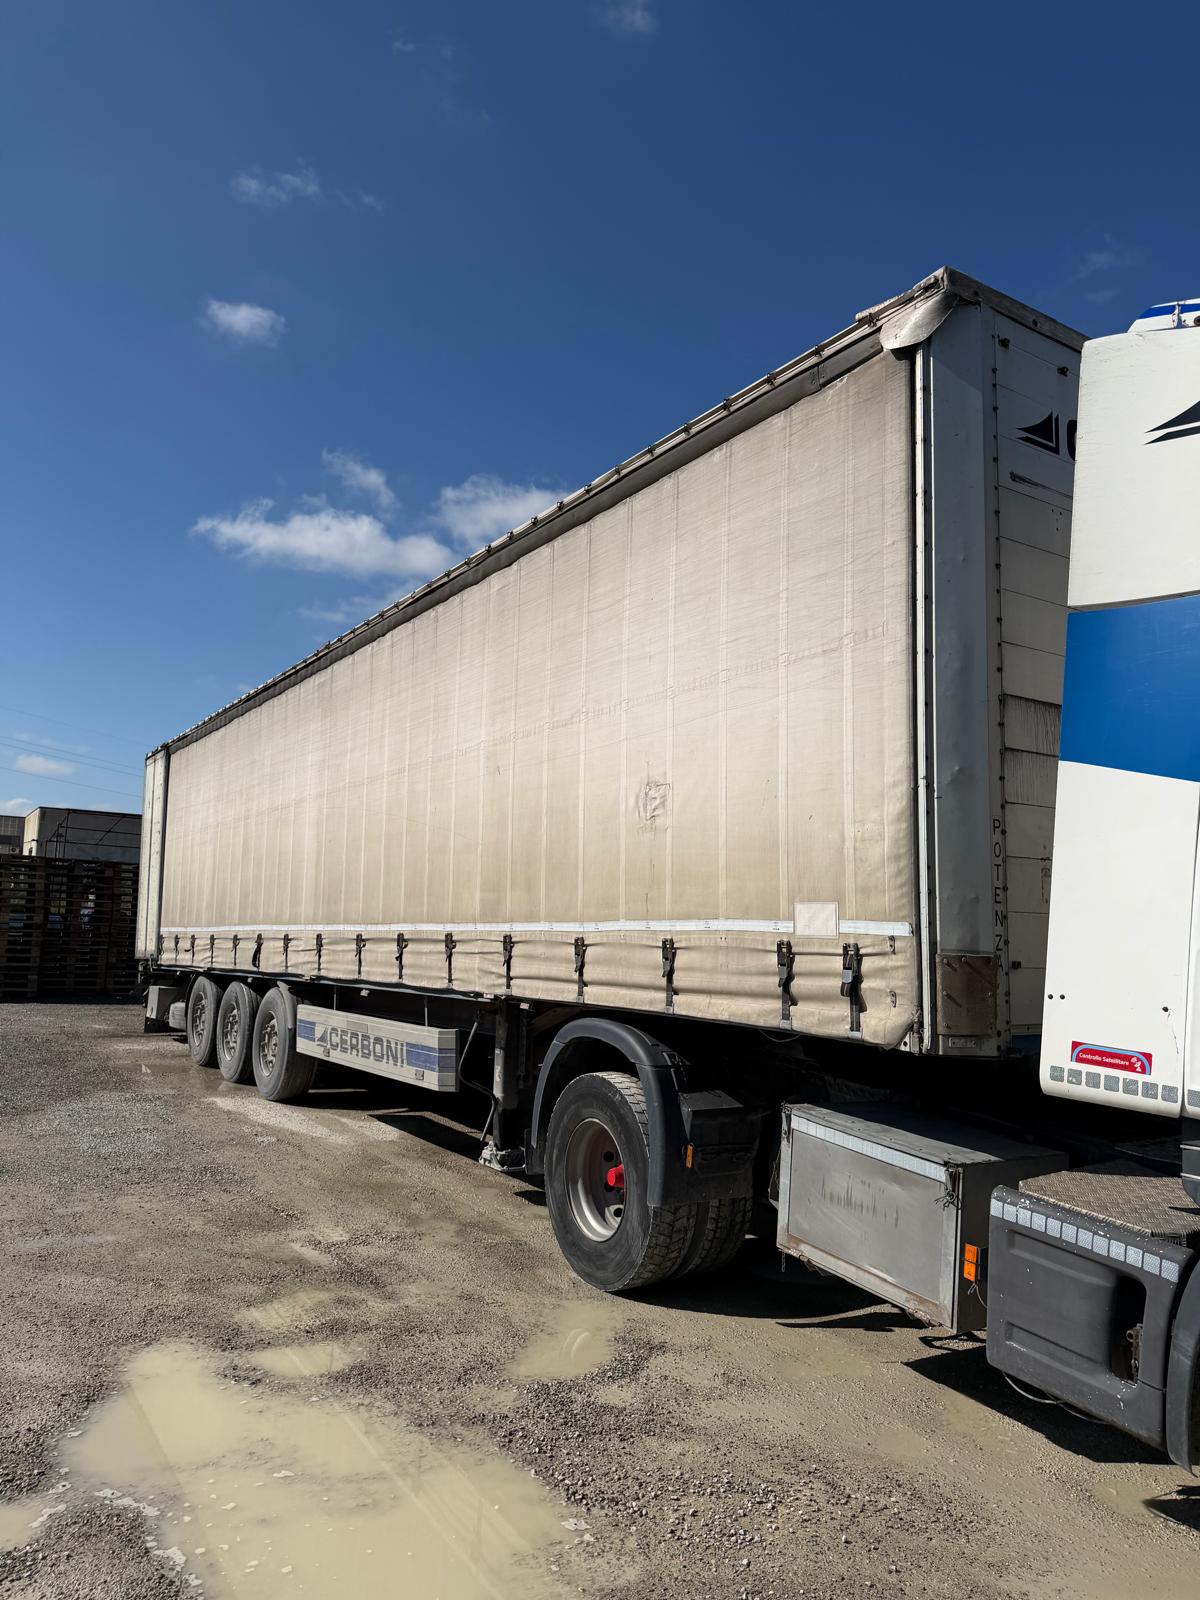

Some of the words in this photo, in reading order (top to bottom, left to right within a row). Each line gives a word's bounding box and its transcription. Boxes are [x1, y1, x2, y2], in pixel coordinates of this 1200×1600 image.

[993, 819, 1004, 972] POTENZA
[329, 1027, 404, 1067] CERBONI
[1079, 1052, 1102, 1061] Controllo
[1102, 1057, 1129, 1065] Satellitare
